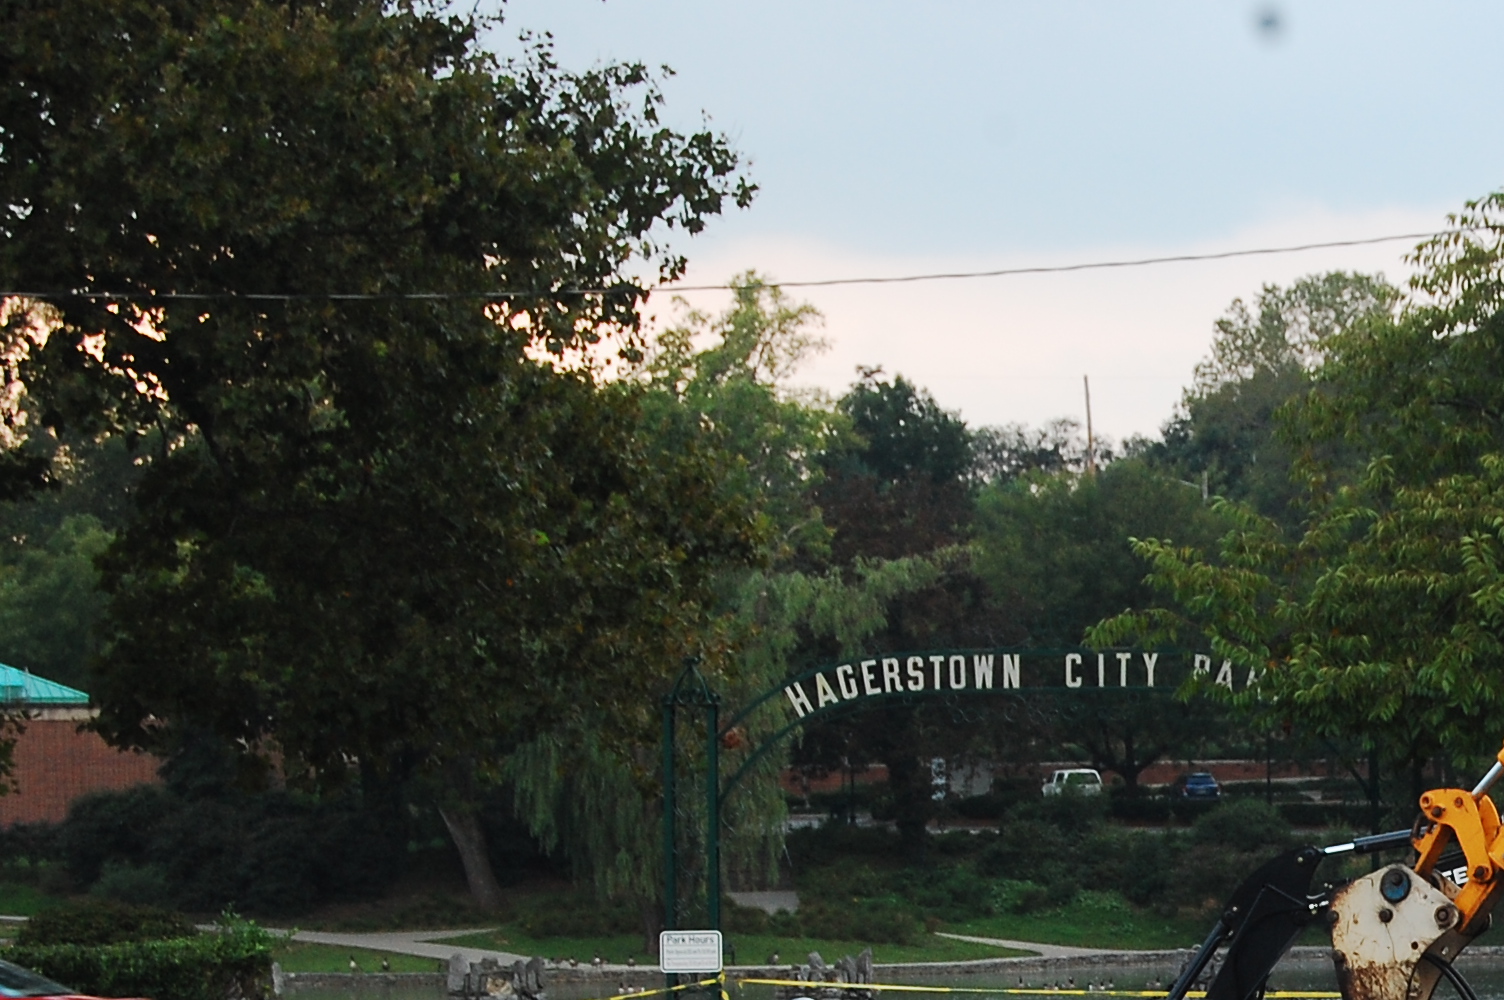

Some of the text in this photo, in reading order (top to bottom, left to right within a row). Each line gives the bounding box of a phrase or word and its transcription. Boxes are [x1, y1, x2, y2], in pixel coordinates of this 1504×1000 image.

[784, 653, 1021, 718] HAGERSTOWN
[1066, 652, 1160, 689] CITY
[666, 934, 715, 945] Park Hours
